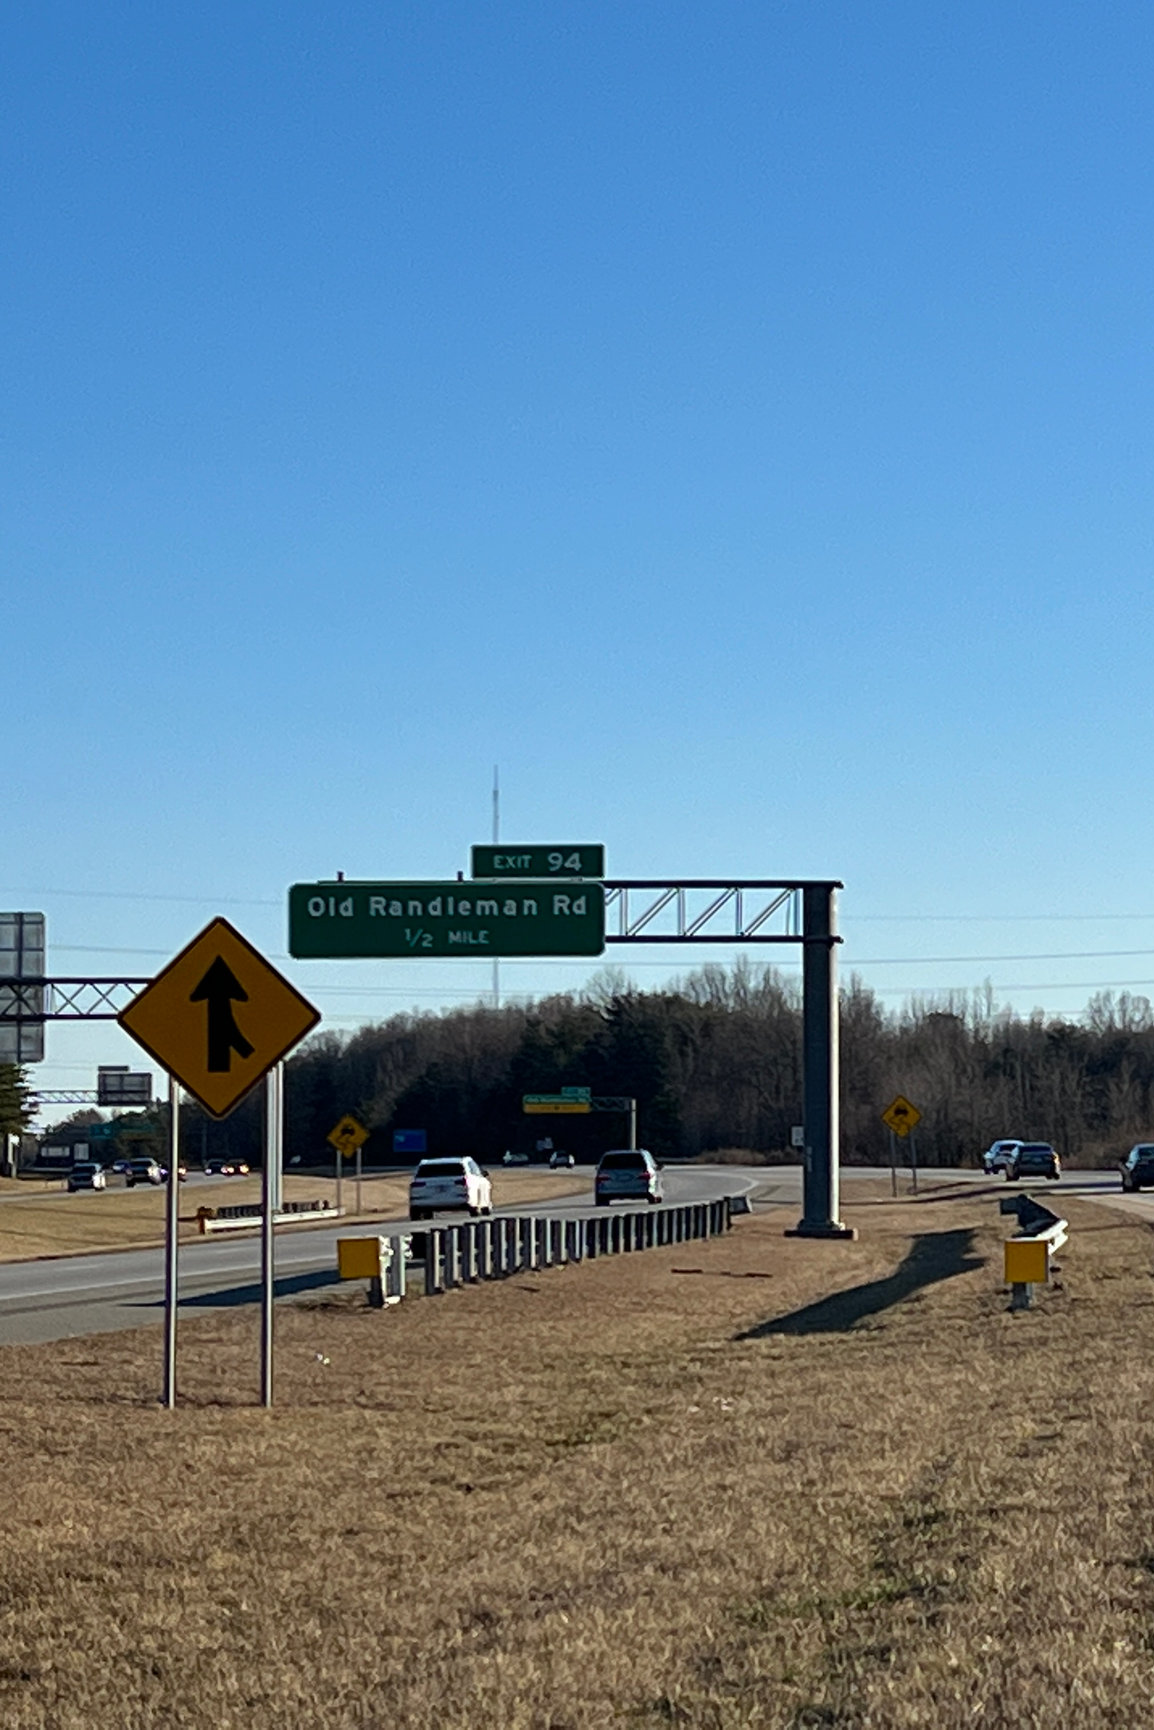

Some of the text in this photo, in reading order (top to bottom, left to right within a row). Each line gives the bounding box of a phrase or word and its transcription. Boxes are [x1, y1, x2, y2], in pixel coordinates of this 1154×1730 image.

[493, 852, 582, 871] EXIT 94
[307, 894, 587, 917] Old Randleman Rd
[448, 930, 490, 945] MILE
